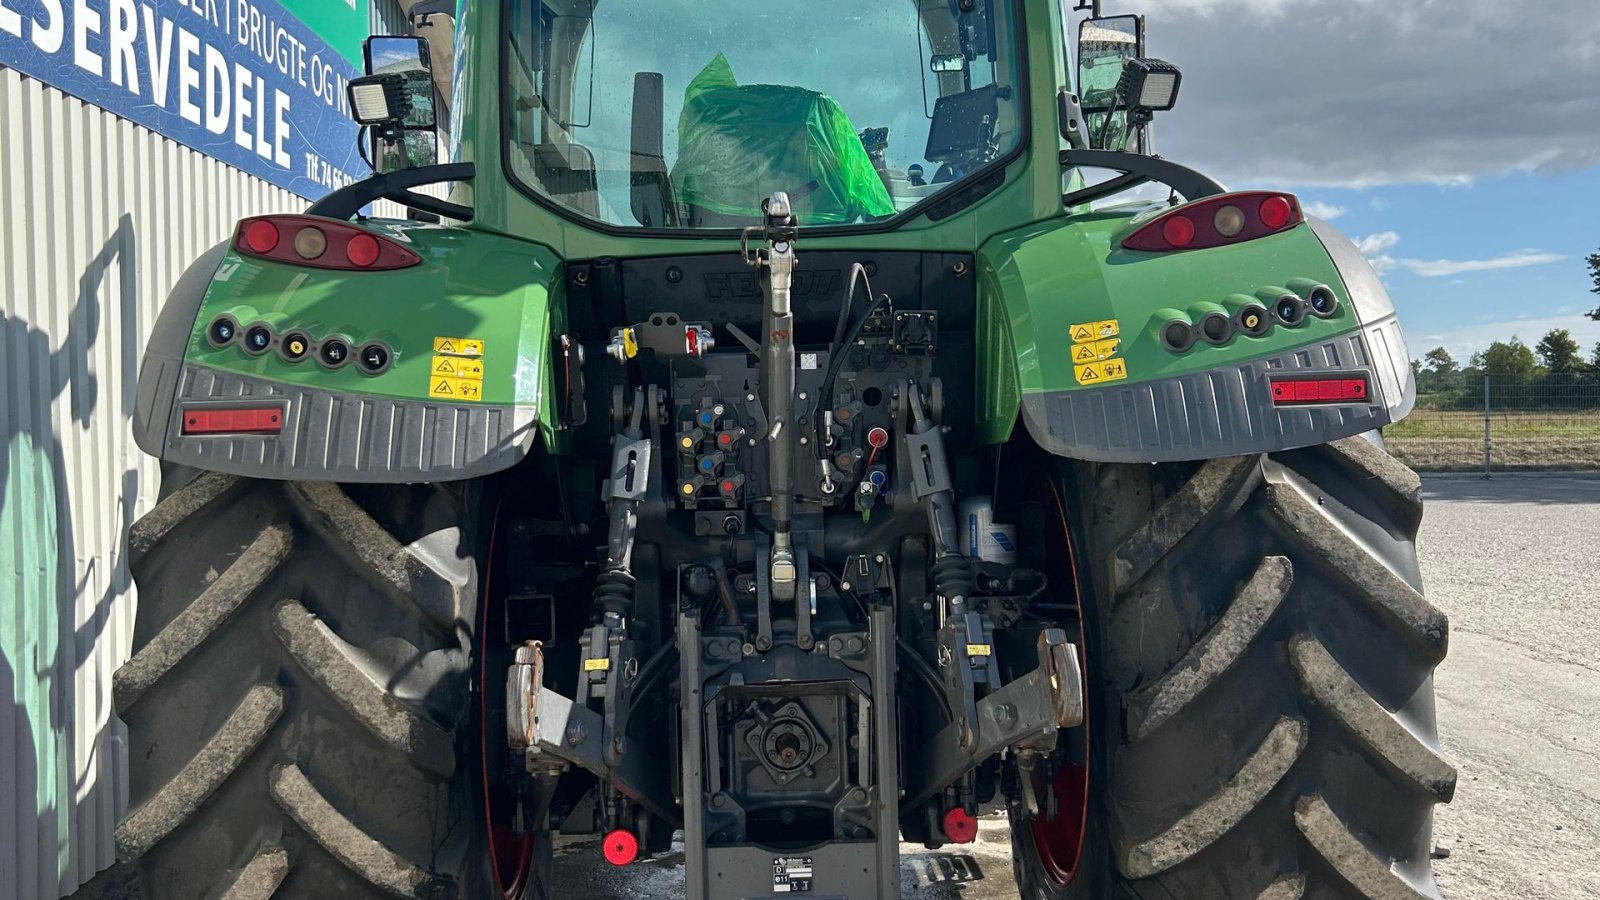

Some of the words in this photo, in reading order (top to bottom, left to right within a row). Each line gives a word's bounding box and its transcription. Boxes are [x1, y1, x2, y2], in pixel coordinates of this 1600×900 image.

[0, 0, 291, 169] ERVEDELE
[238, 0, 307, 88] BRUGTE
[311, 55, 333, 106] OG
[306, 152, 321, 184] Tlf.
[321, 161, 332, 189] 74
[704, 269, 840, 298] FEDT
